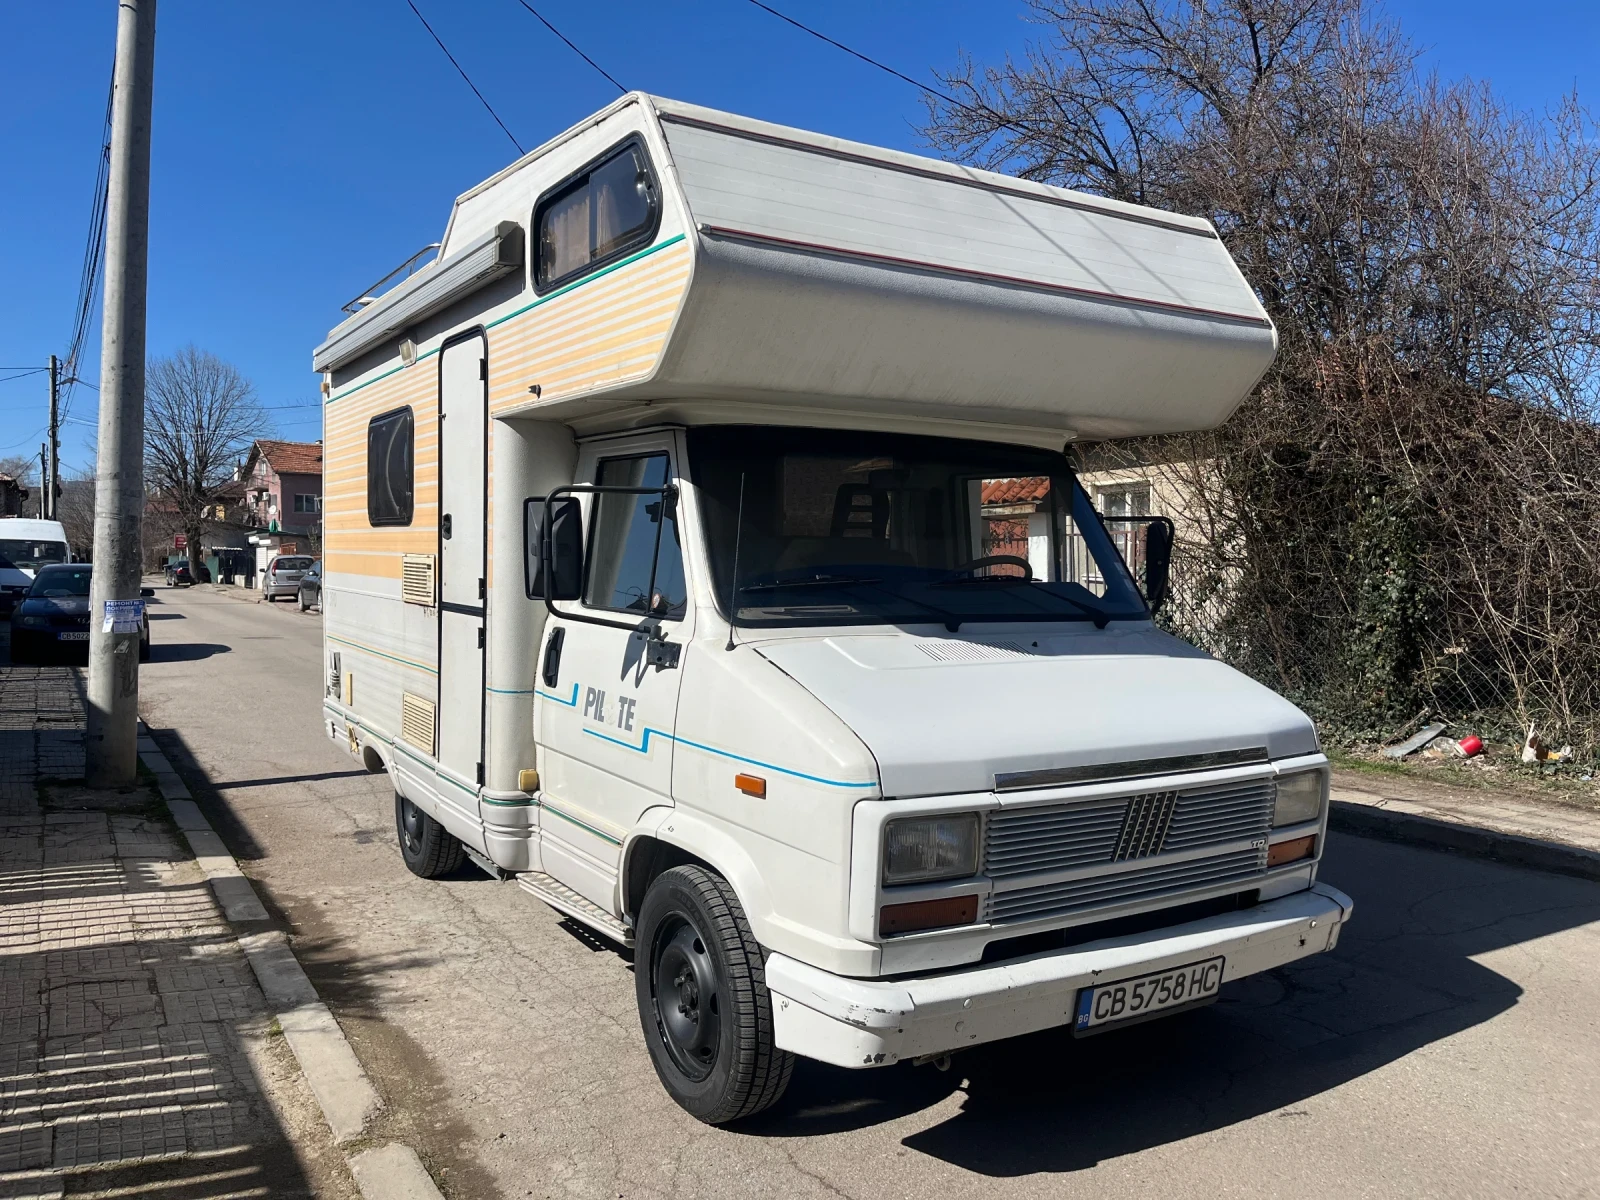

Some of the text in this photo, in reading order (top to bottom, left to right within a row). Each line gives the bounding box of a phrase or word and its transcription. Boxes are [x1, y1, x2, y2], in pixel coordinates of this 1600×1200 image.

[62, 632, 71, 640] CB
[584, 687, 637, 732] PILTE
[1094, 963, 1219, 1020] CB 5758 HC
[1077, 1013, 1089, 1024] BG
